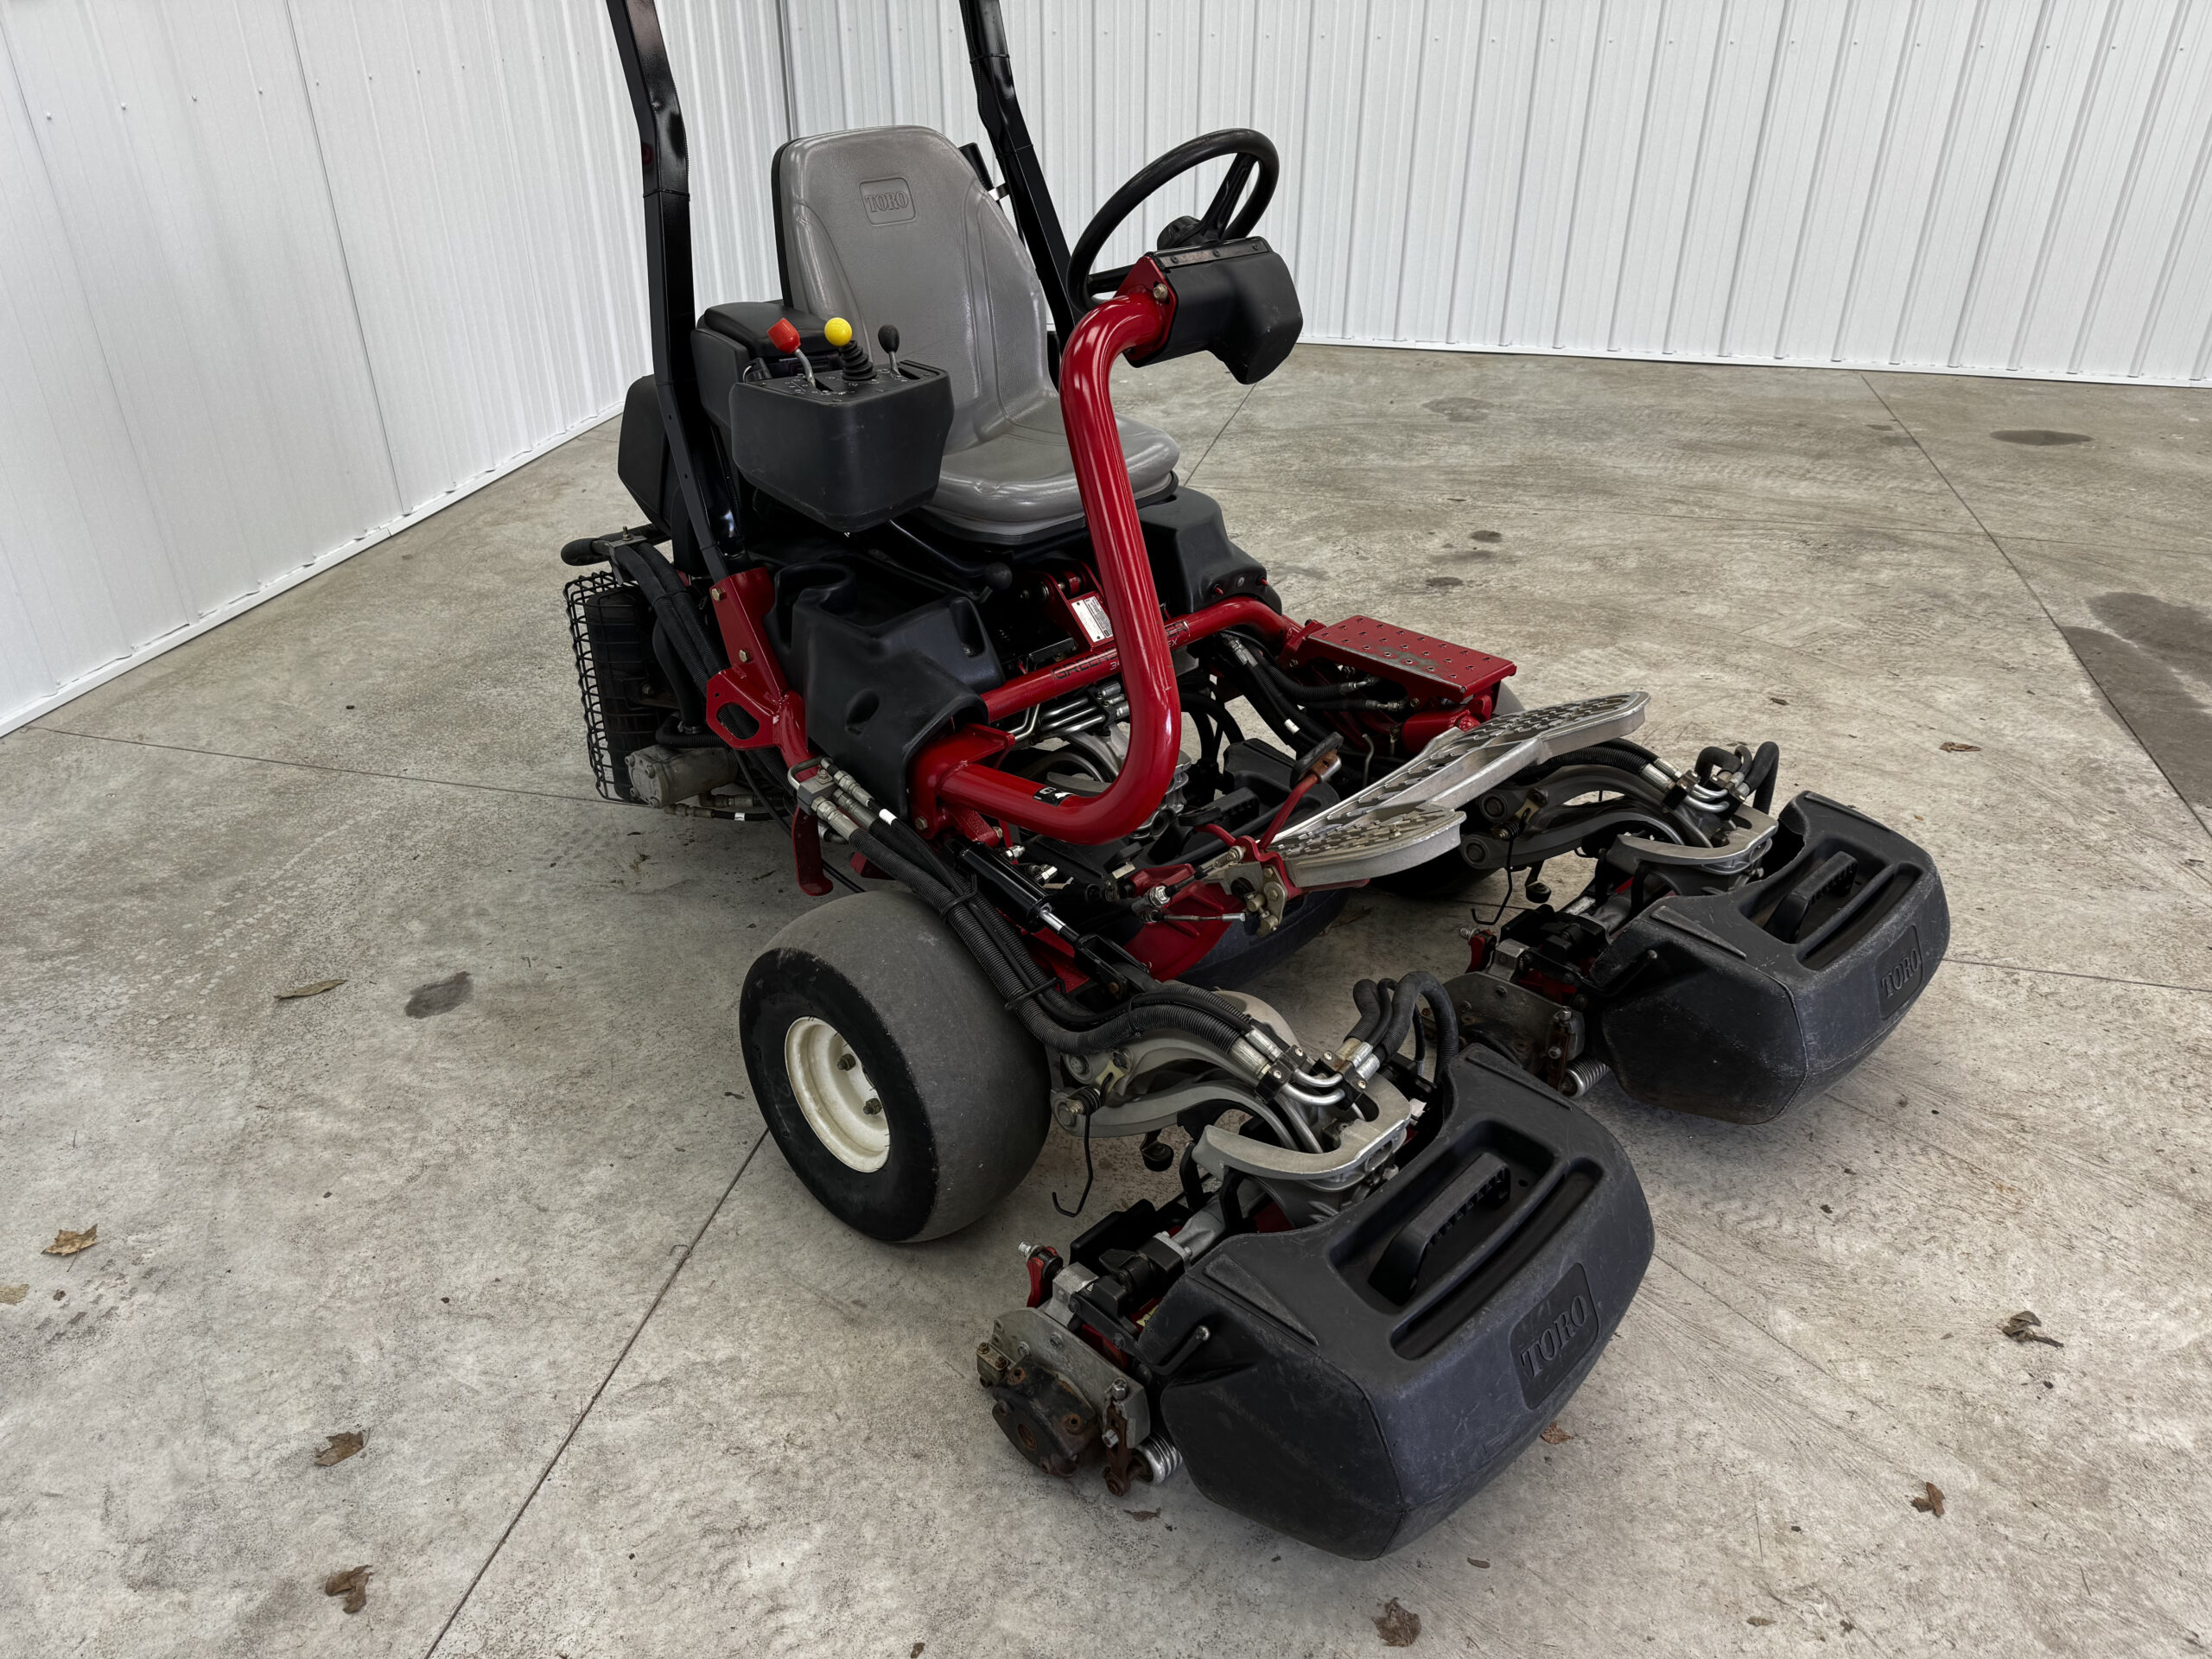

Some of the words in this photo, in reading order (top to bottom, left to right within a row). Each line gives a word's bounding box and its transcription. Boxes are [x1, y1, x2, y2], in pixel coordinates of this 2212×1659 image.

[865, 191, 908, 213] TORO
[1880, 948, 1918, 998] TORO
[1521, 1295, 1588, 1377] TORO
